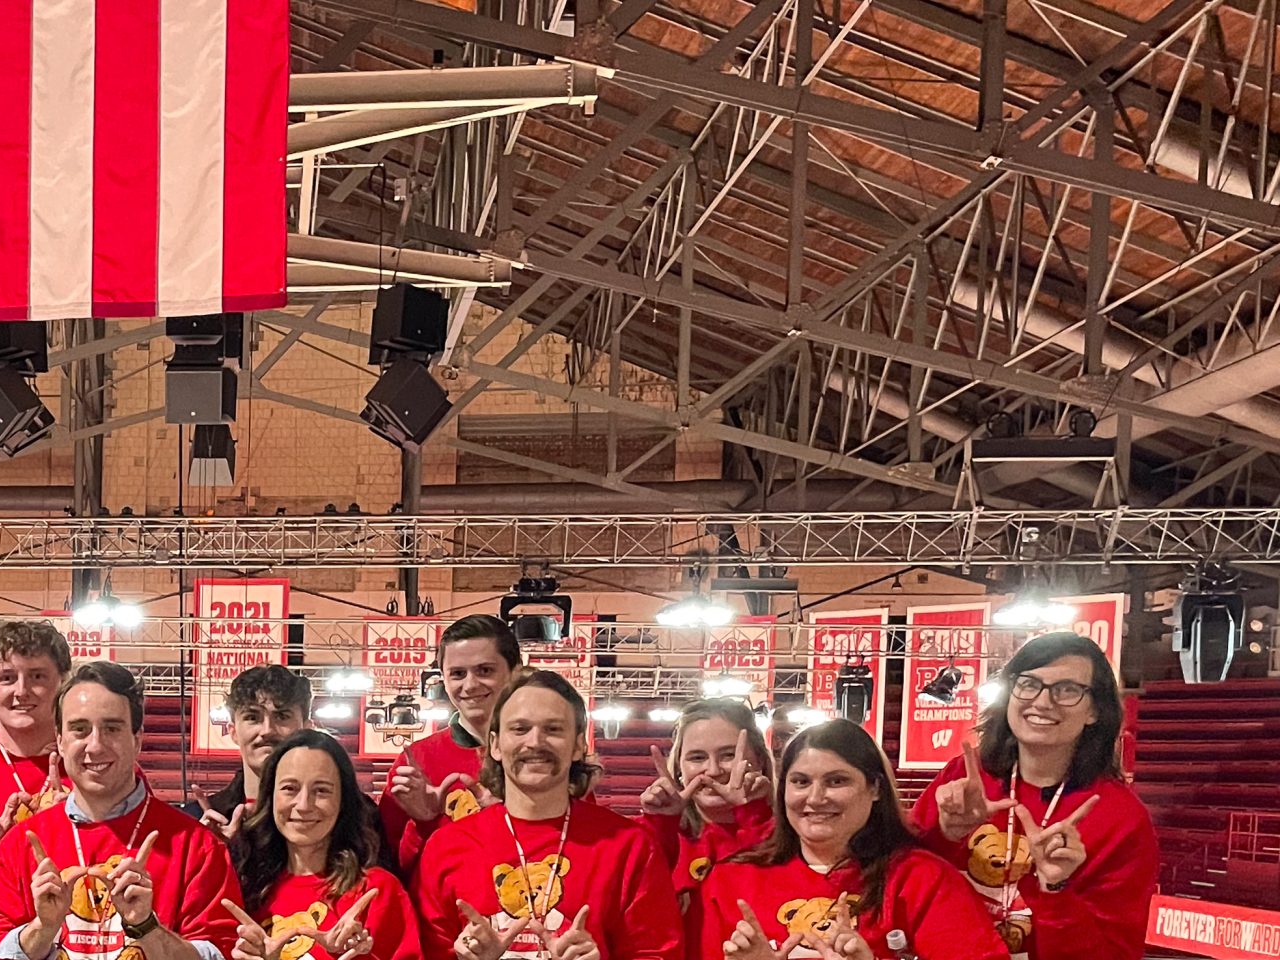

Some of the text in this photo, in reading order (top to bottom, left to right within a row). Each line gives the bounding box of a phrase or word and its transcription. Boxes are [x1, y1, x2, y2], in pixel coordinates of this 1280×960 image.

[210, 601, 270, 635] 2021
[206, 651, 272, 667] NATIONAL
[374, 637, 426, 664] 2019
[913, 709, 973, 722] CHAMPIONS
[931, 729, 953, 749] W
[68, 933, 118, 945] WISCOSIN
[1156, 907, 1280, 957] FOREVER FORWARD
